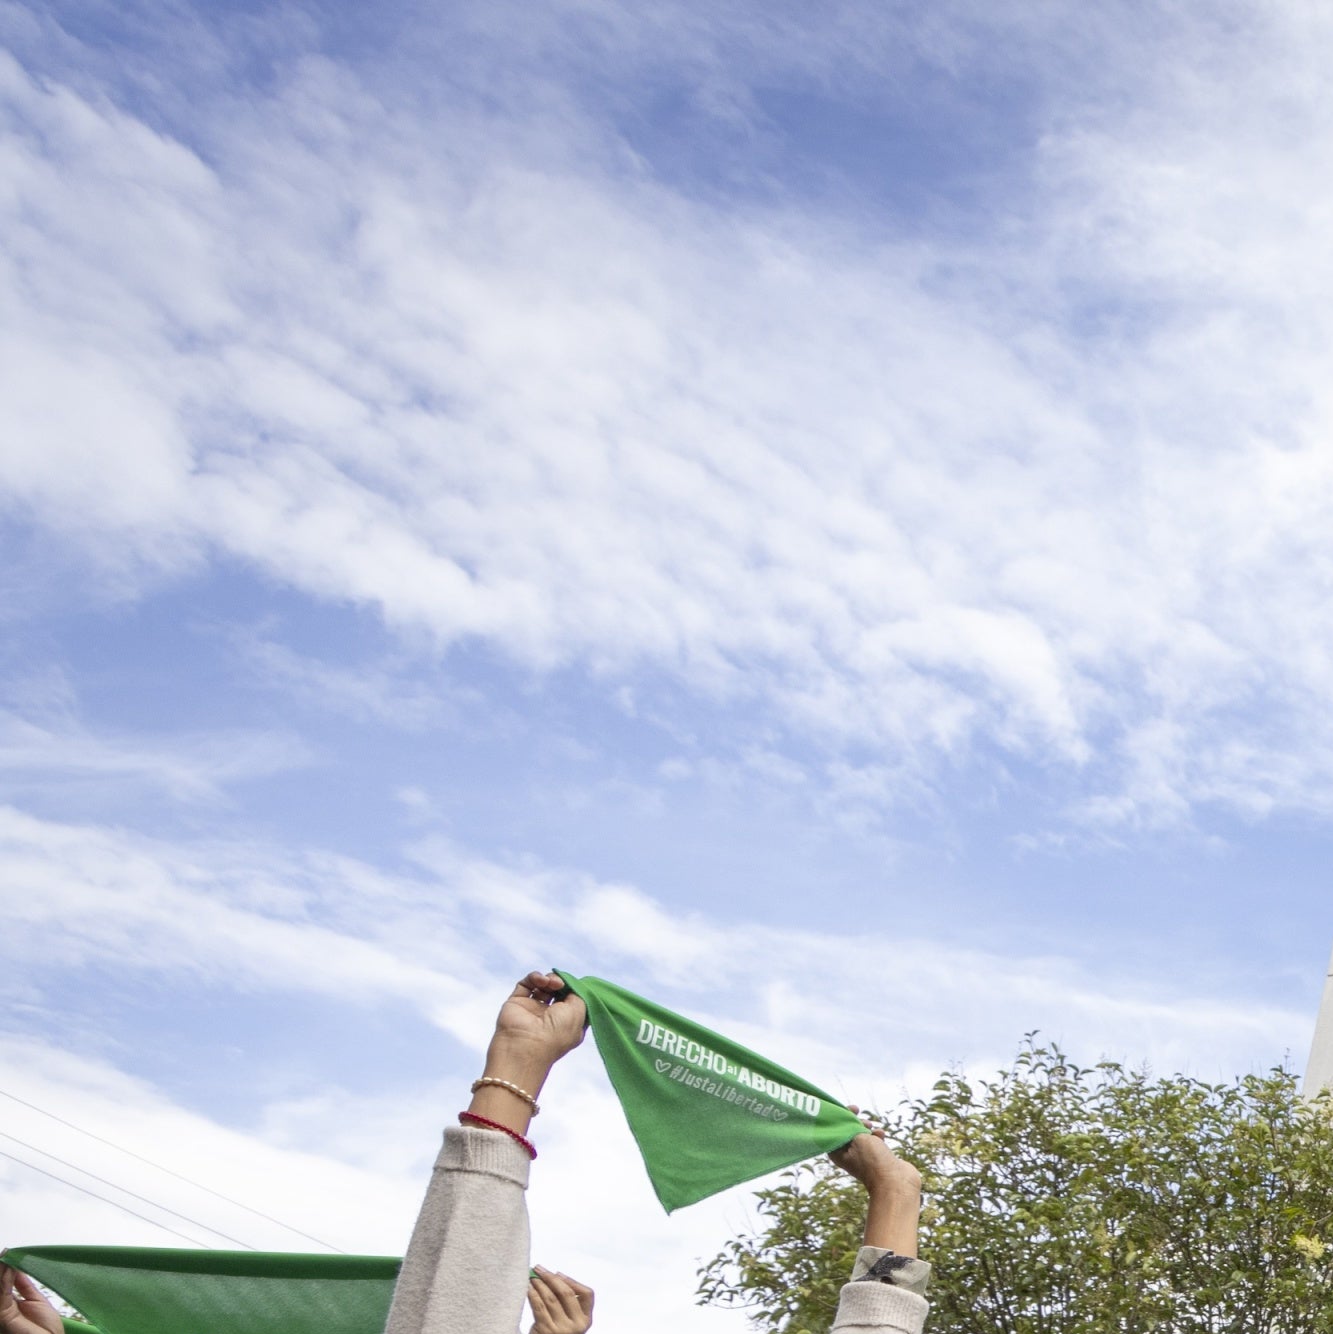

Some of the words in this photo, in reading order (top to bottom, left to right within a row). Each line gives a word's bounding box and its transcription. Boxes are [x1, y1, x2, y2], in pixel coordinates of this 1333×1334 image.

[636, 1019, 727, 1075] DERECHO
[727, 1064, 737, 1076] al
[738, 1067, 821, 1117] ABORTO
[669, 1065, 774, 1117] #JustaLibertad
